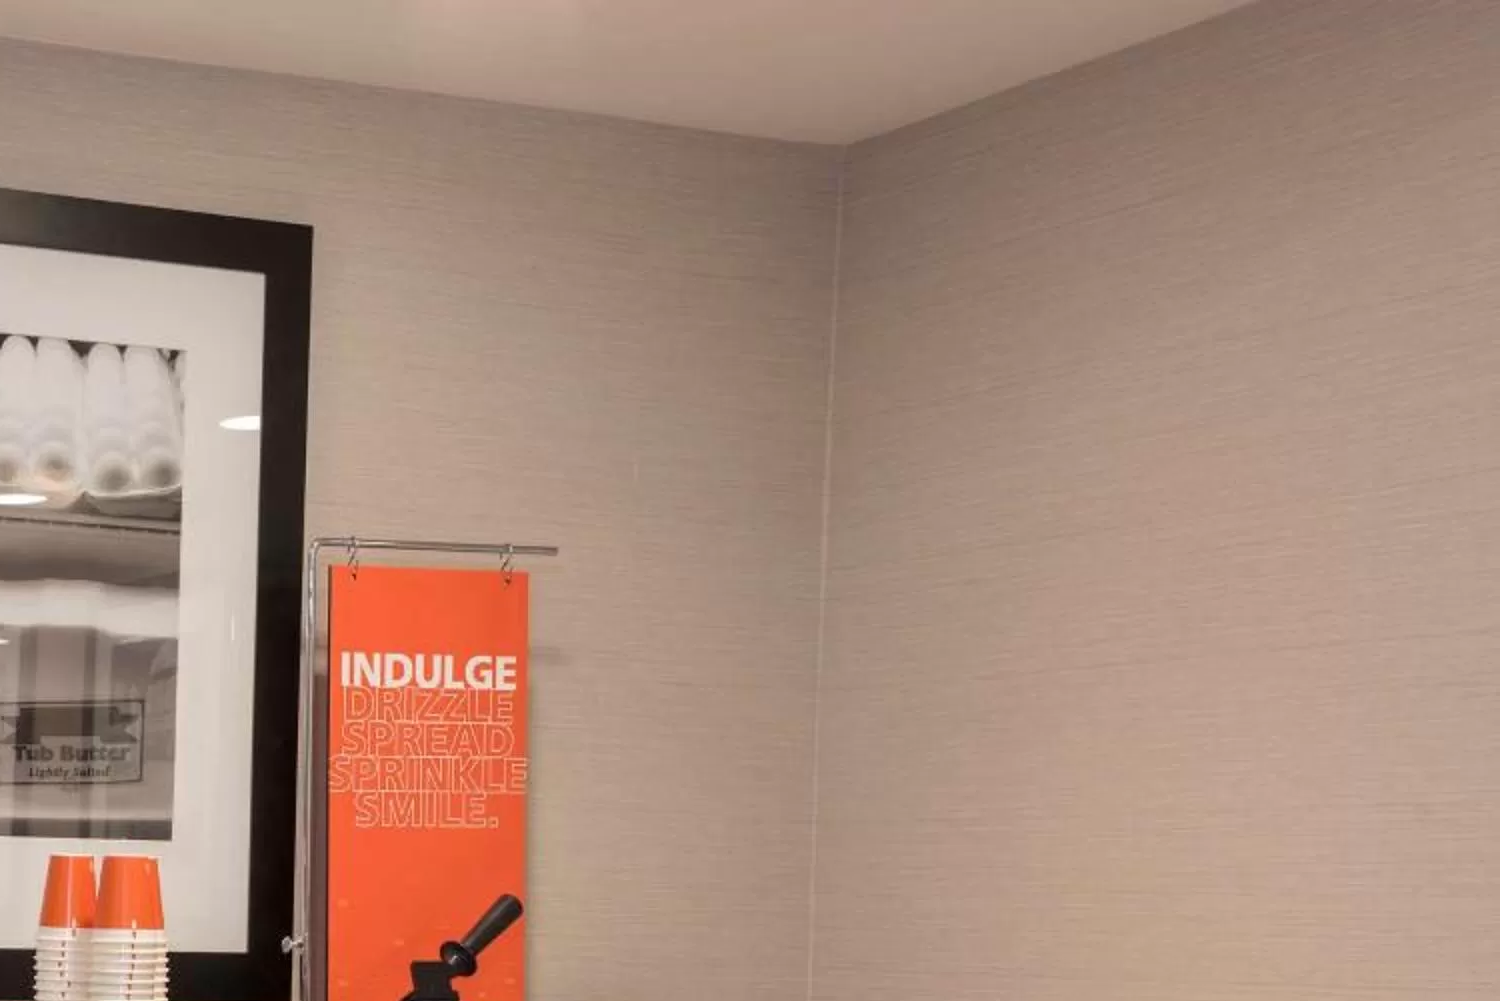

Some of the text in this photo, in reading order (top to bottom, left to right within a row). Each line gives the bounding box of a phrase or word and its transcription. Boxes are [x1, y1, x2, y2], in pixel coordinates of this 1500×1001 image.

[340, 651, 517, 690] INDULGE
[343, 685, 514, 723] DRIZZLE
[13, 743, 130, 762] Tub Butter
[340, 721, 516, 757] SPREAD
[328, 755, 529, 794] SPRINKLE
[355, 789, 499, 828] SMILE.
